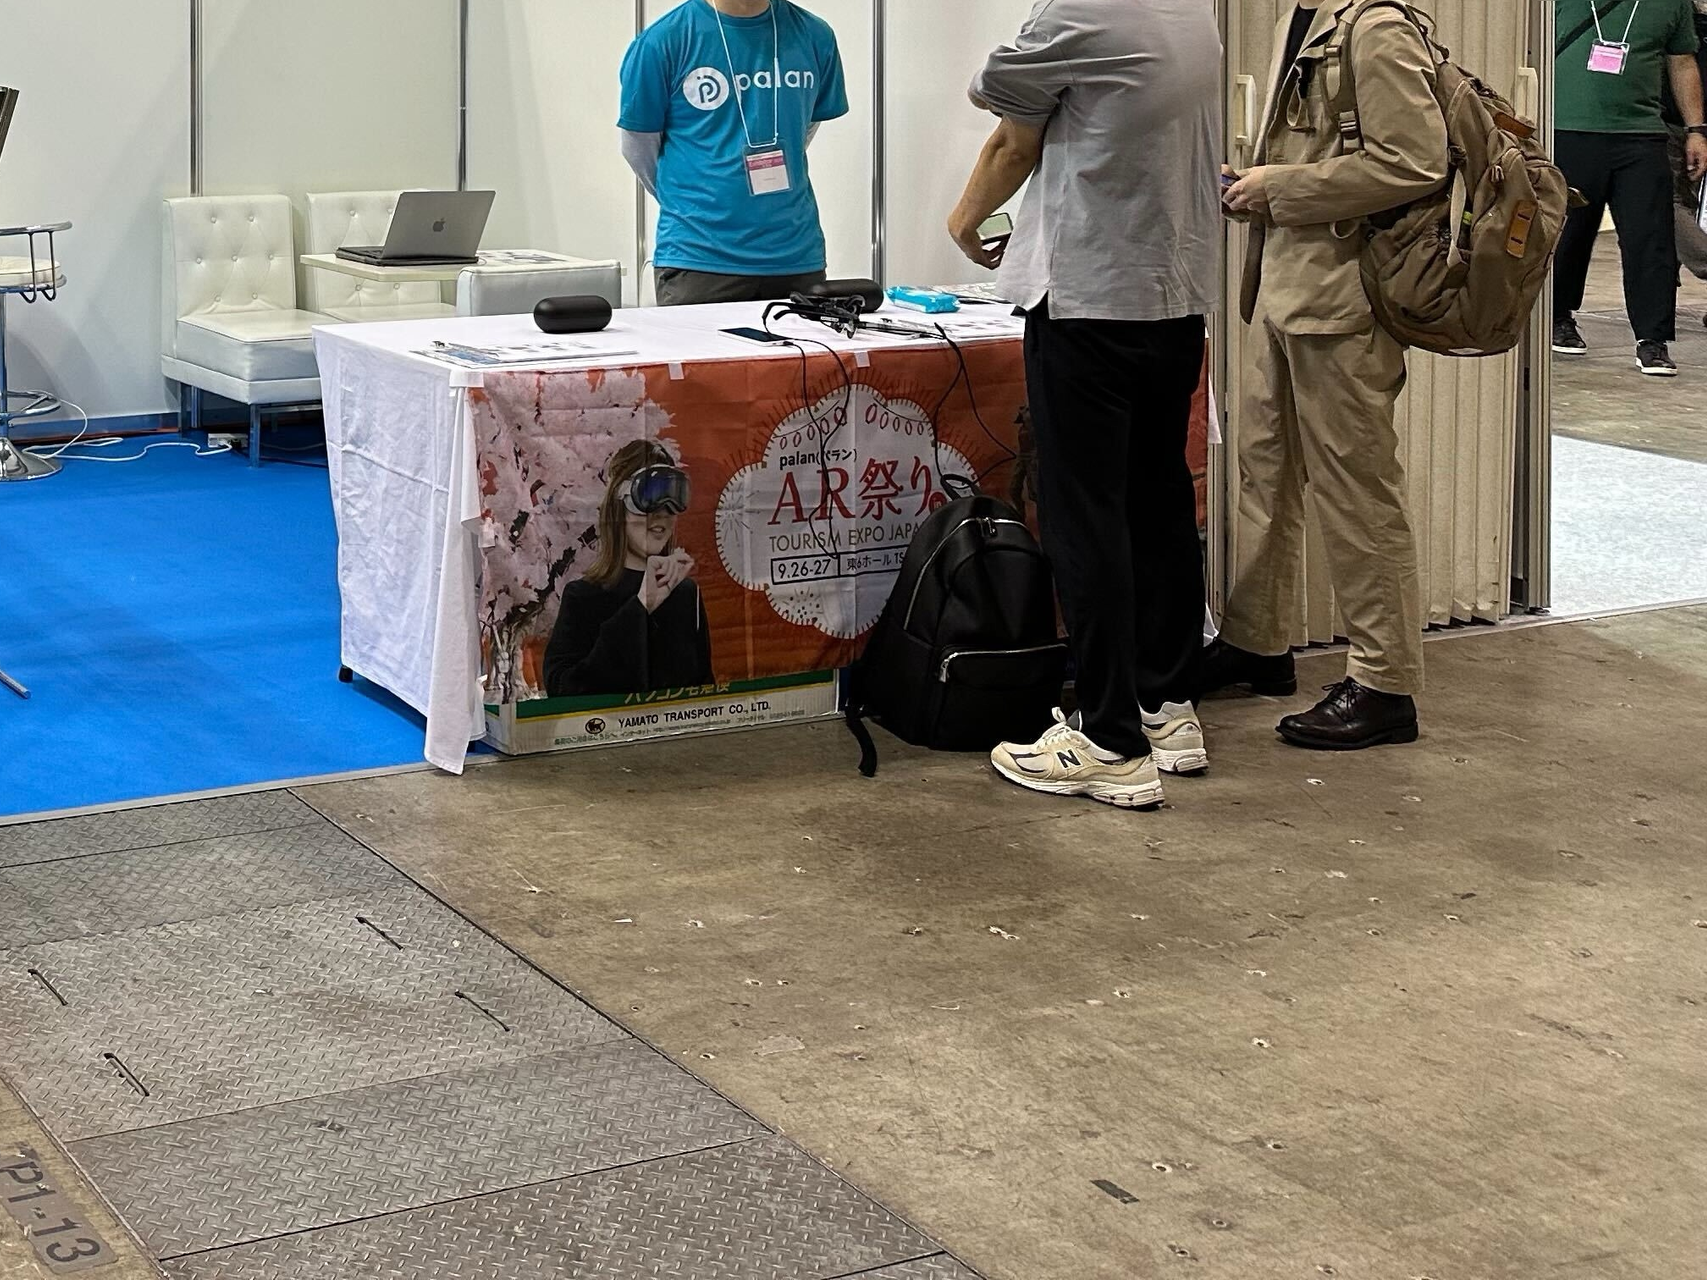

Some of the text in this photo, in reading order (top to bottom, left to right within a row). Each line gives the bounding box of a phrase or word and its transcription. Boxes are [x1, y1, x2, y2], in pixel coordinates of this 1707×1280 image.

[736, 65, 815, 105] palan
[767, 456, 932, 526] AR祭り
[770, 531, 842, 553] TOURISM
[848, 526, 885, 546] EXPO
[778, 558, 831, 580] 9.26-27
[847, 553, 892, 571] 東6ホール
[618, 713, 659, 729] YAMATO
[664, 706, 724, 723] TRANSPORT
[750, 701, 772, 713] LTD.
